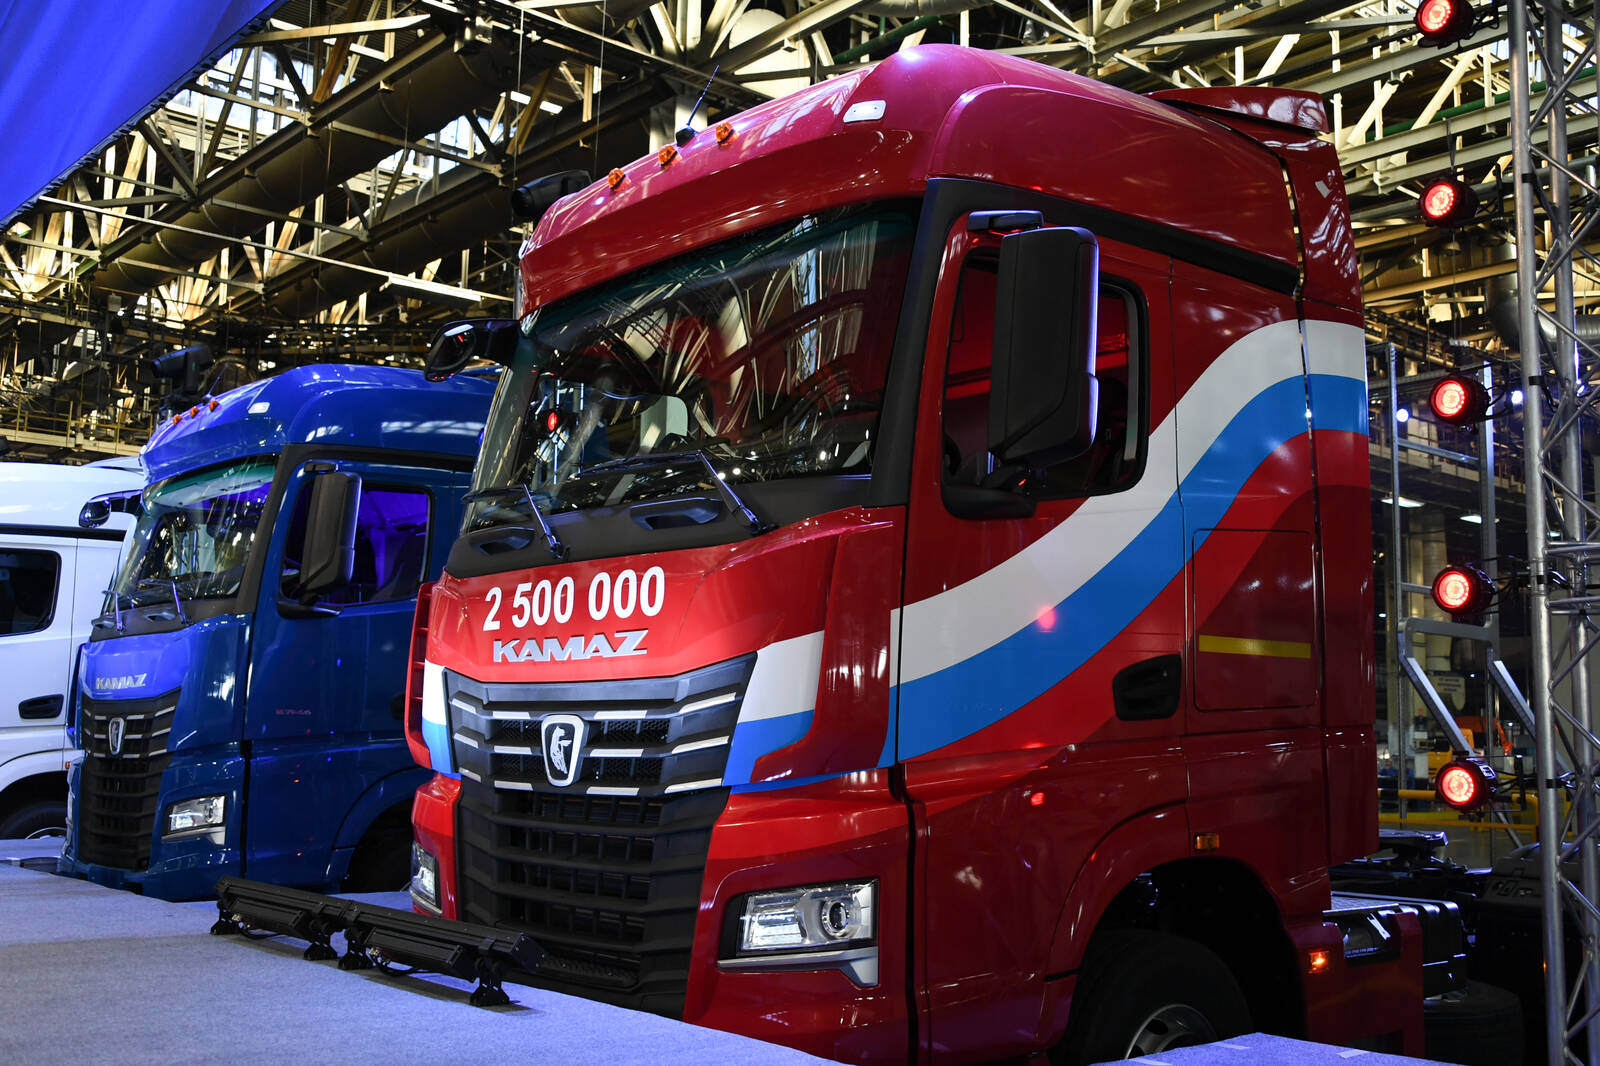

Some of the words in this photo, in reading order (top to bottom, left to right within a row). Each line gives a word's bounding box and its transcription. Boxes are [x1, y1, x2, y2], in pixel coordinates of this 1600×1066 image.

[482, 587, 502, 632] 2
[511, 576, 575, 629] 500
[588, 566, 665, 621] 000
[493, 629, 649, 663] KAMAZ
[95, 673, 147, 690] KAMAZ
